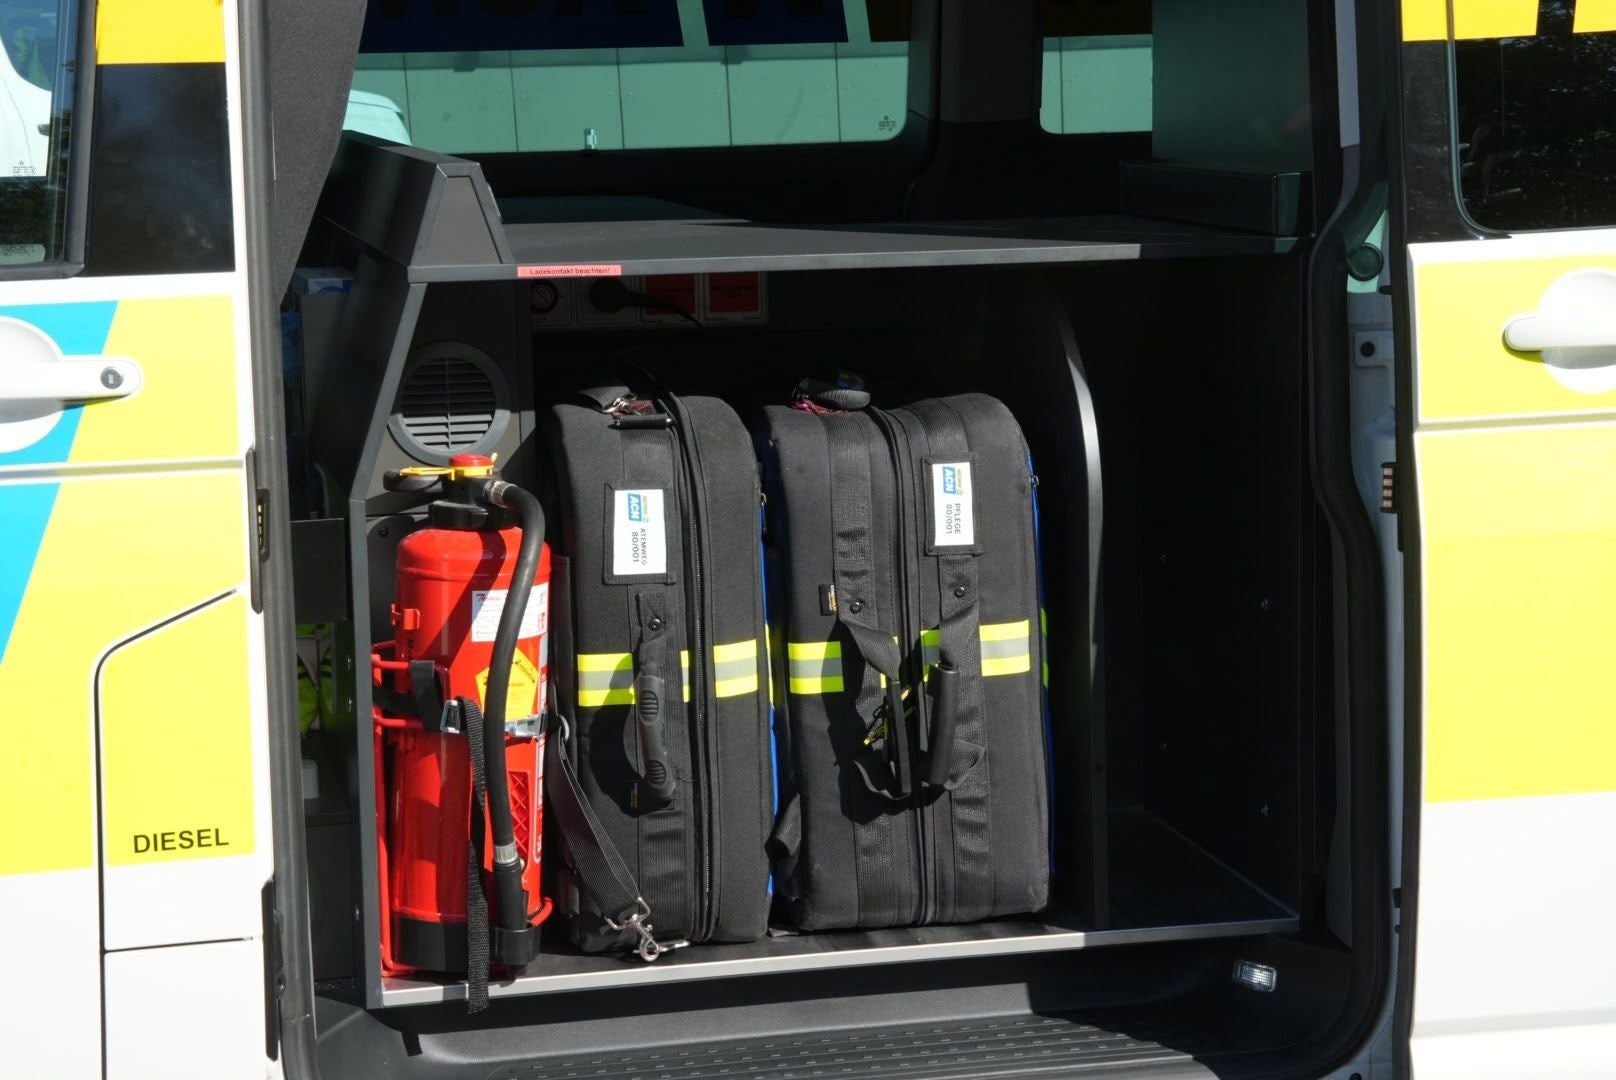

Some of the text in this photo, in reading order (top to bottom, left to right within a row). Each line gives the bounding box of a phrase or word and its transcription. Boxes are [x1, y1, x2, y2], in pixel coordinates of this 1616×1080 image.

[529, 264, 610, 276] Ladekontakt beachten!
[944, 467, 955, 494] ACN
[629, 494, 641, 521] ACN
[133, 828, 230, 854] DIESEL
